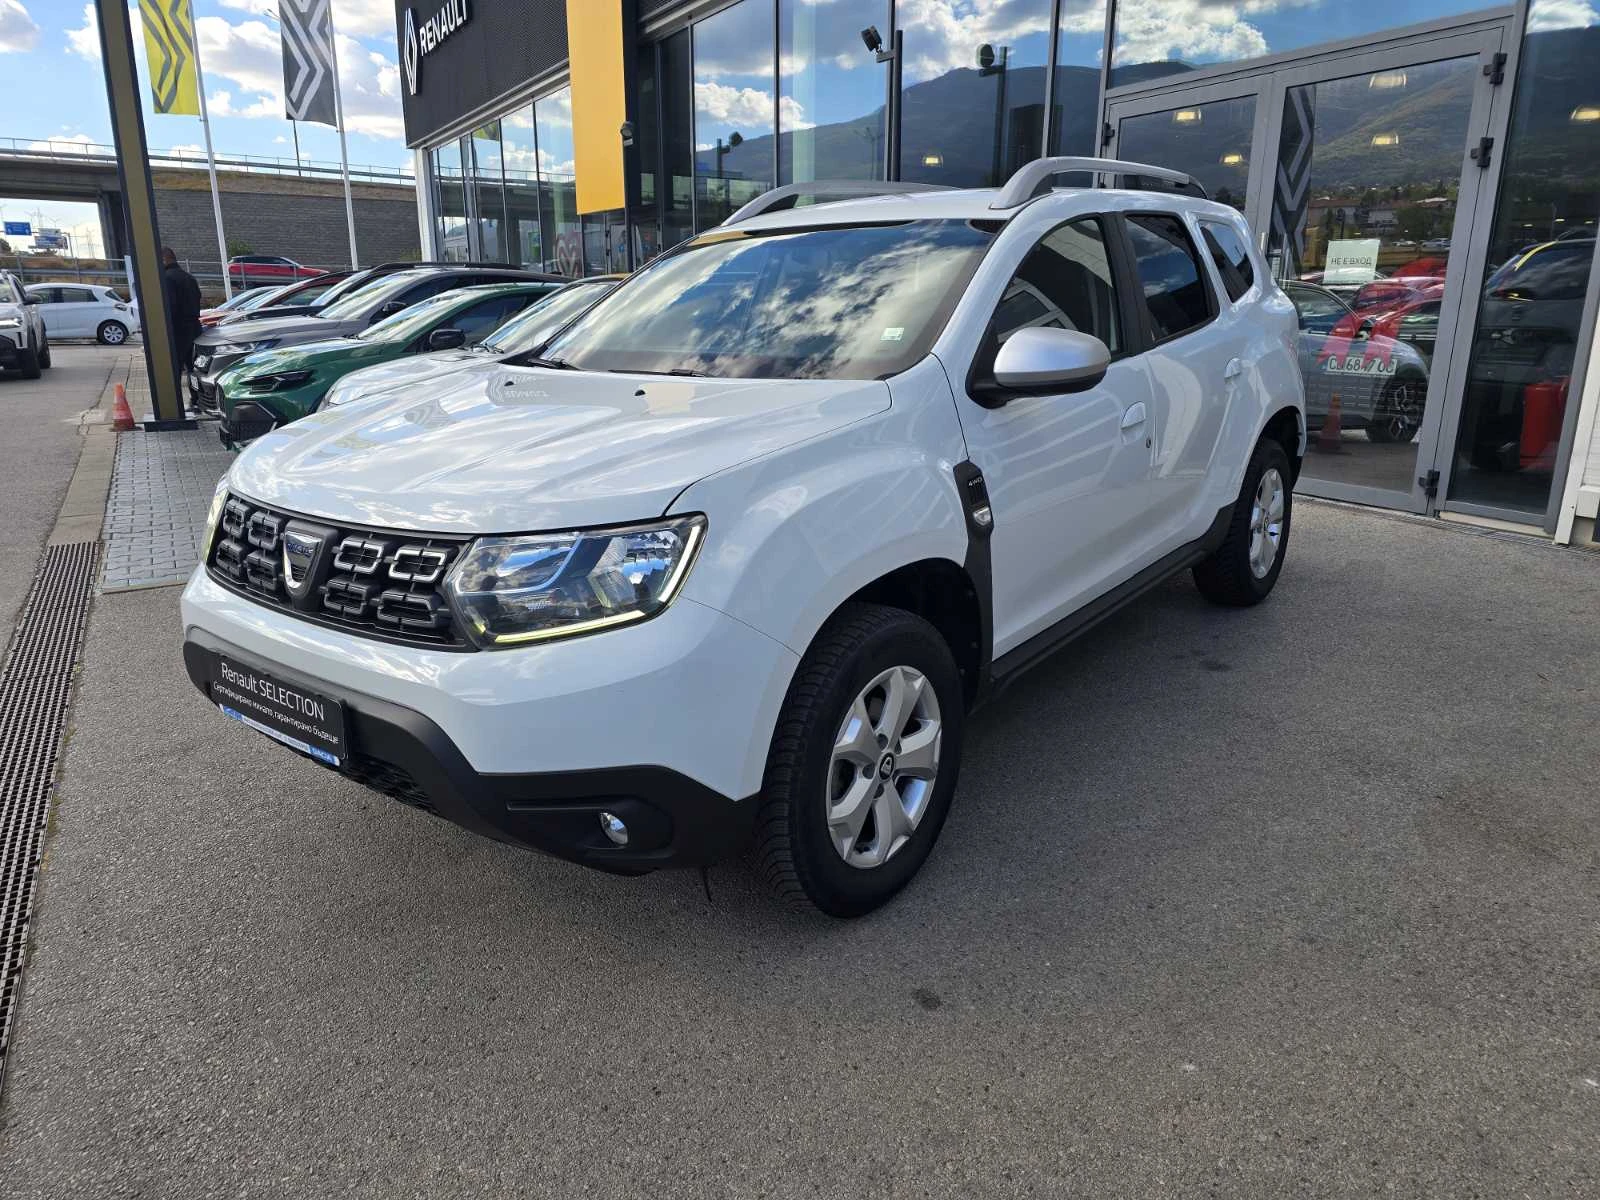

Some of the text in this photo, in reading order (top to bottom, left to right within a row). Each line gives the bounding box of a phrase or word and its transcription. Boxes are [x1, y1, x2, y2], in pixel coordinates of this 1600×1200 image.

[420, 0, 467, 56] RENAULT
[221, 662, 257, 694] Renault
[260, 679, 324, 721] SELECTION
